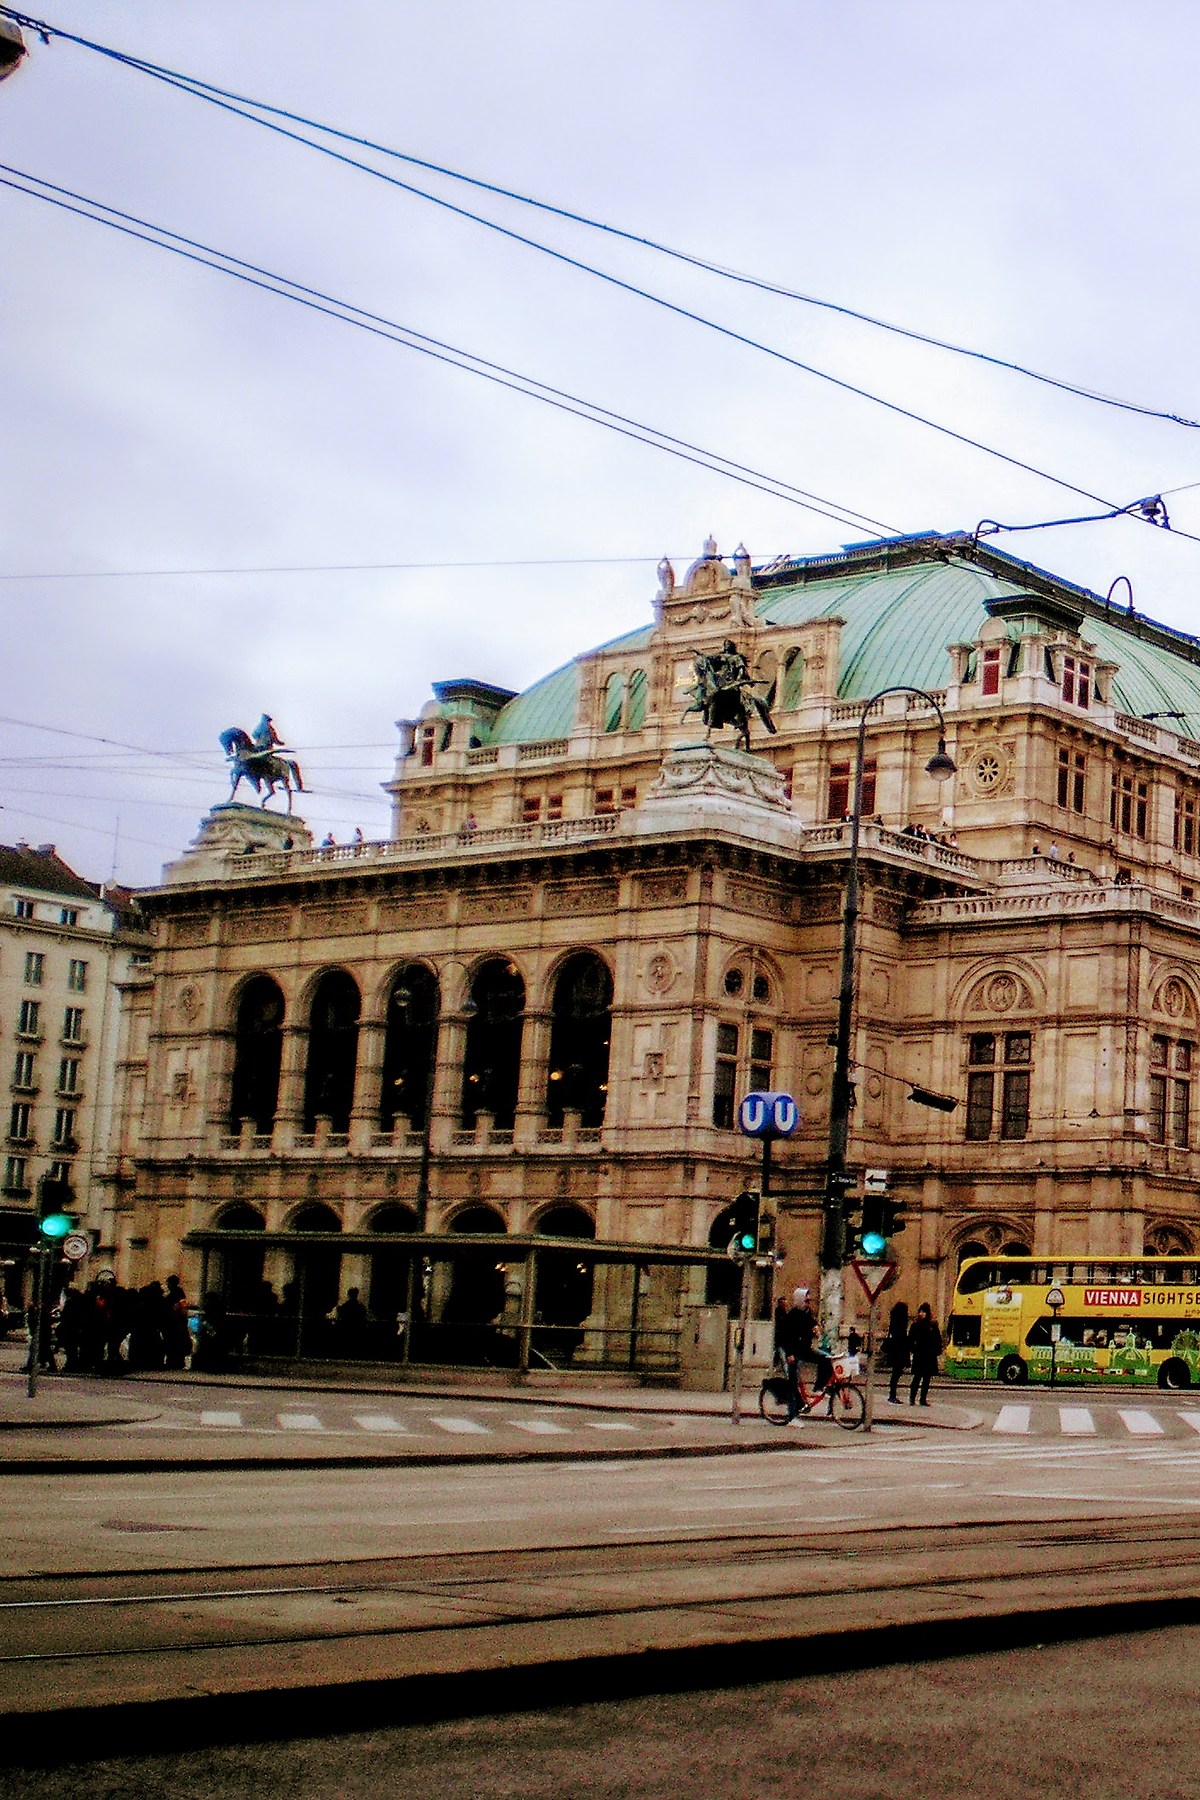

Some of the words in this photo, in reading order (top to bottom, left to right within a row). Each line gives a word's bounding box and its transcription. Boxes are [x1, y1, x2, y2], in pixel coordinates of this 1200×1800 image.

[742, 1100, 764, 1131] U
[774, 1101, 795, 1131] U
[1087, 1291, 1139, 1305] VIENNA
